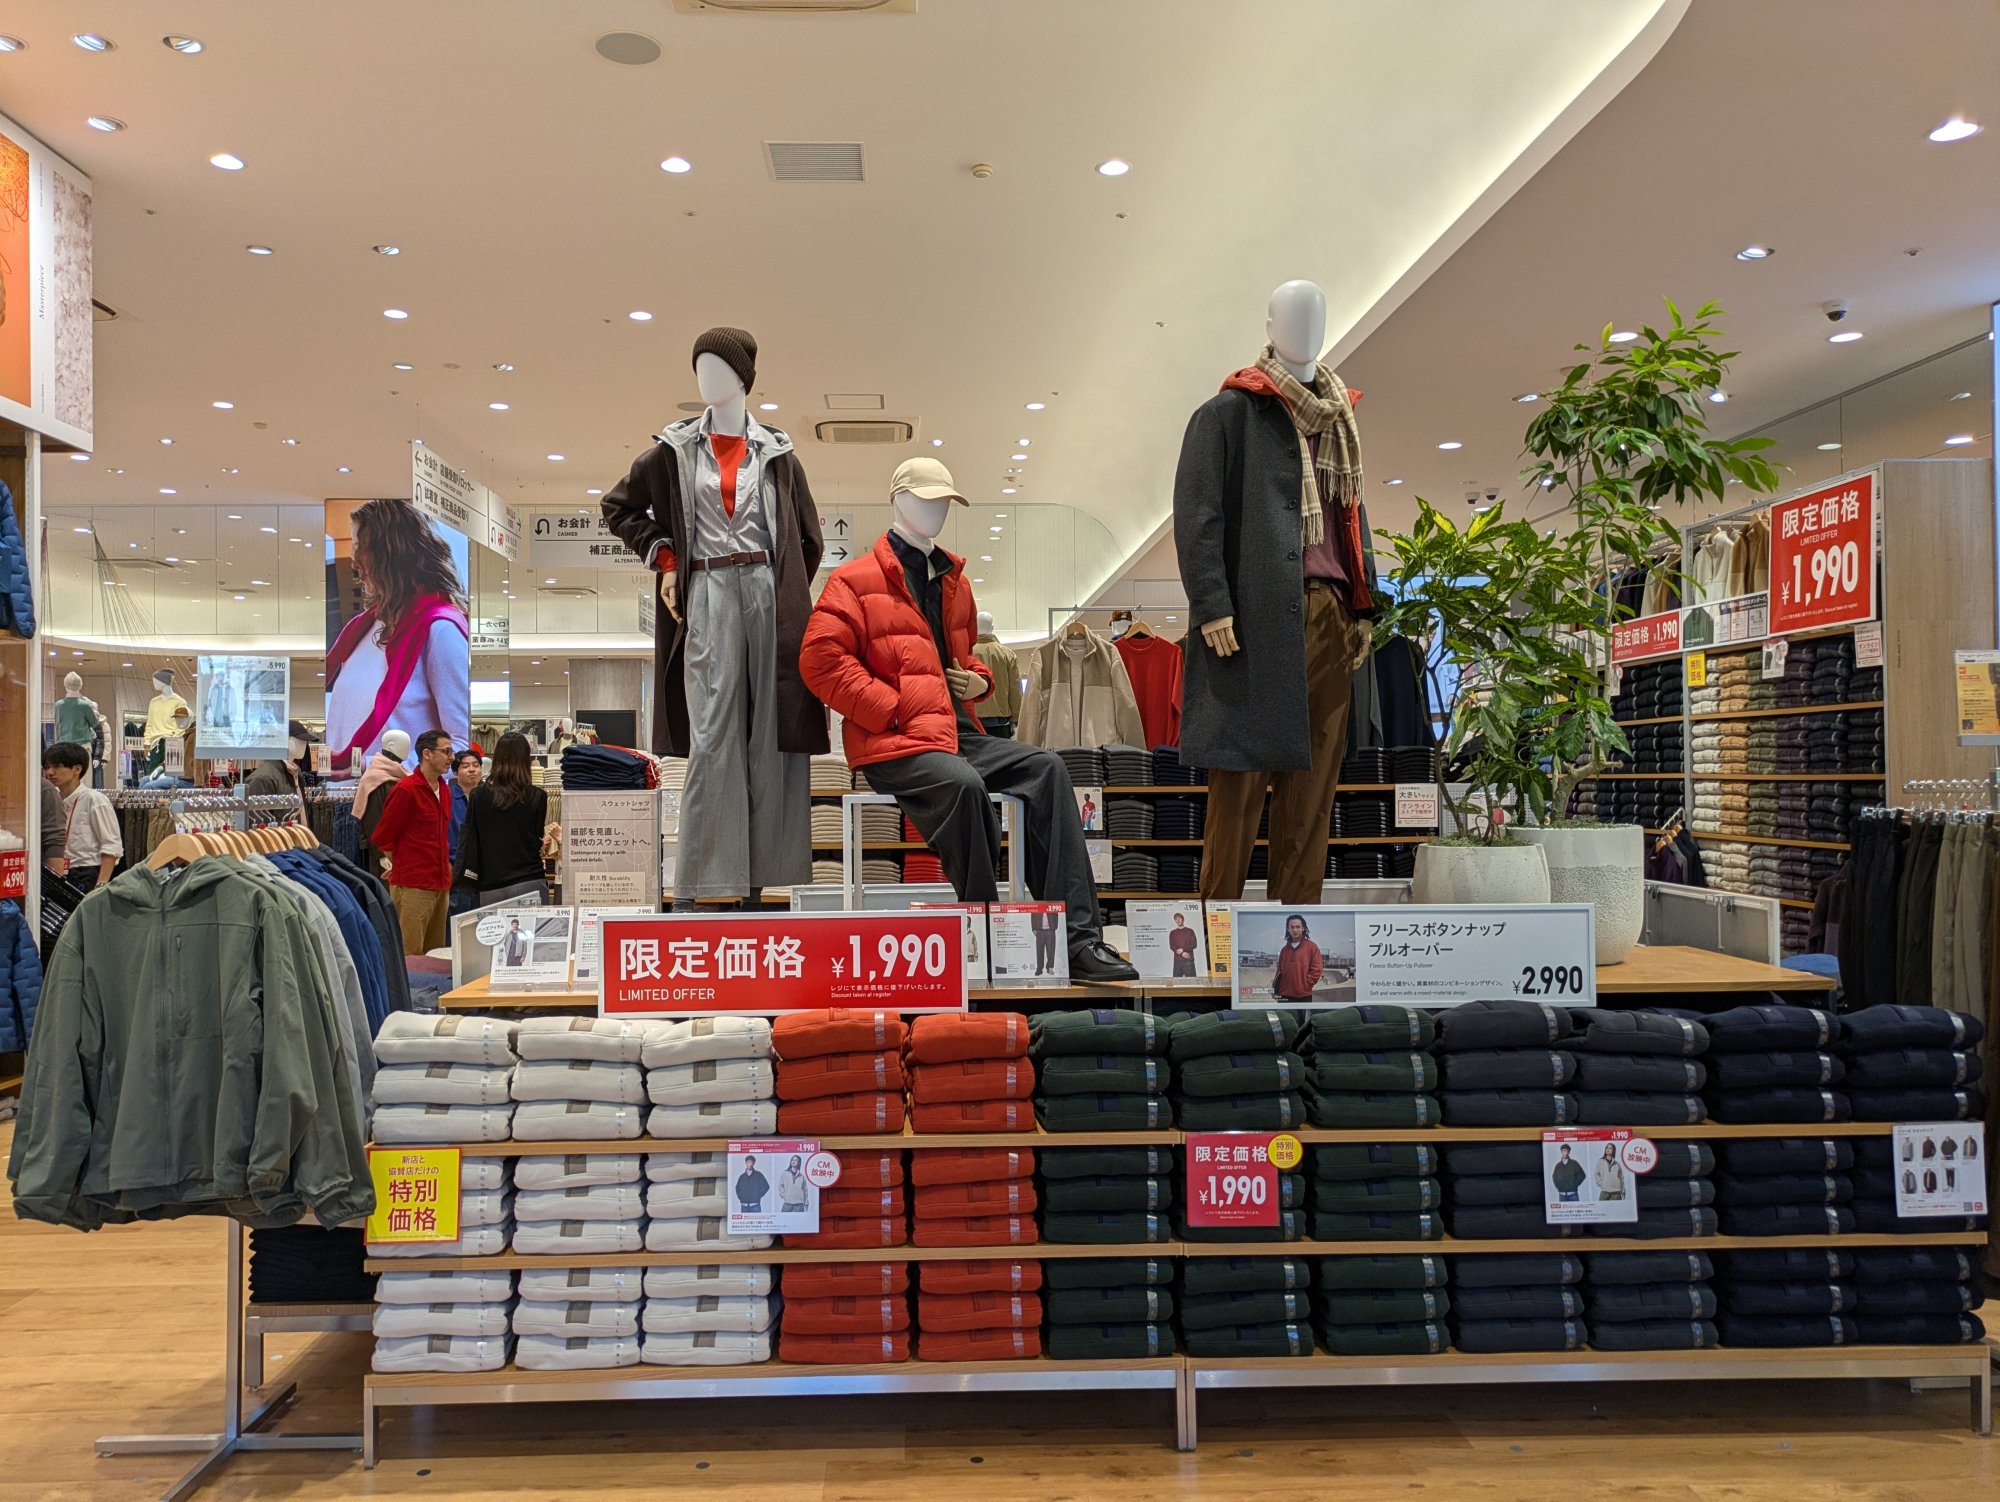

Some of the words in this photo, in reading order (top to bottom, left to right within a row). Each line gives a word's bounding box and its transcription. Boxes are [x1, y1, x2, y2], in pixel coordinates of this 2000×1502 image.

[424, 452, 437, 471] お会計
[1782, 490, 1860, 540] 限定価格
[558, 518, 591, 528] お会計
[1800, 534, 1820, 546] LIMITED
[1820, 529, 1838, 541] OFFER
[1782, 541, 1858, 606] ¥1,990
[1615, 626, 1649, 648] 限定価格
[1653, 620, 1678, 642] ¥1,990
[1690, 659, 1701, 669] 特別
[1690, 671, 1701, 681] 価格
[570, 828, 625, 836] 細部を見直し、
[570, 838, 651, 847] 現代のスウェットへ。
[3, 871, 24, 888] ¥6,990
[1369, 922, 1506, 937] フリースボタンナップ
[1369, 943, 1453, 957] プルオーバー
[619, 935, 806, 980] 限定価格
[831, 934, 946, 982] ¥1,990
[1512, 965, 1583, 996] ¥2,990
[619, 989, 669, 1002] LIMITED
[672, 988, 715, 1000] OFFER
[1276, 1141, 1294, 1150] 特別
[1634, 1146, 1647, 1154] CM
[402, 1156, 425, 1164] 新店と
[1196, 1146, 1268, 1162] 限定価格
[1276, 1151, 1294, 1160] 価格
[1627, 1154, 1651, 1164] 放映中
[389, 1167, 439, 1176] 協賛店だけの
[811, 1168, 835, 1178] 放映中
[389, 1179, 437, 1204] 特別
[1199, 1176, 1266, 1208] ¥1,990
[388, 1207, 437, 1232] 価格
